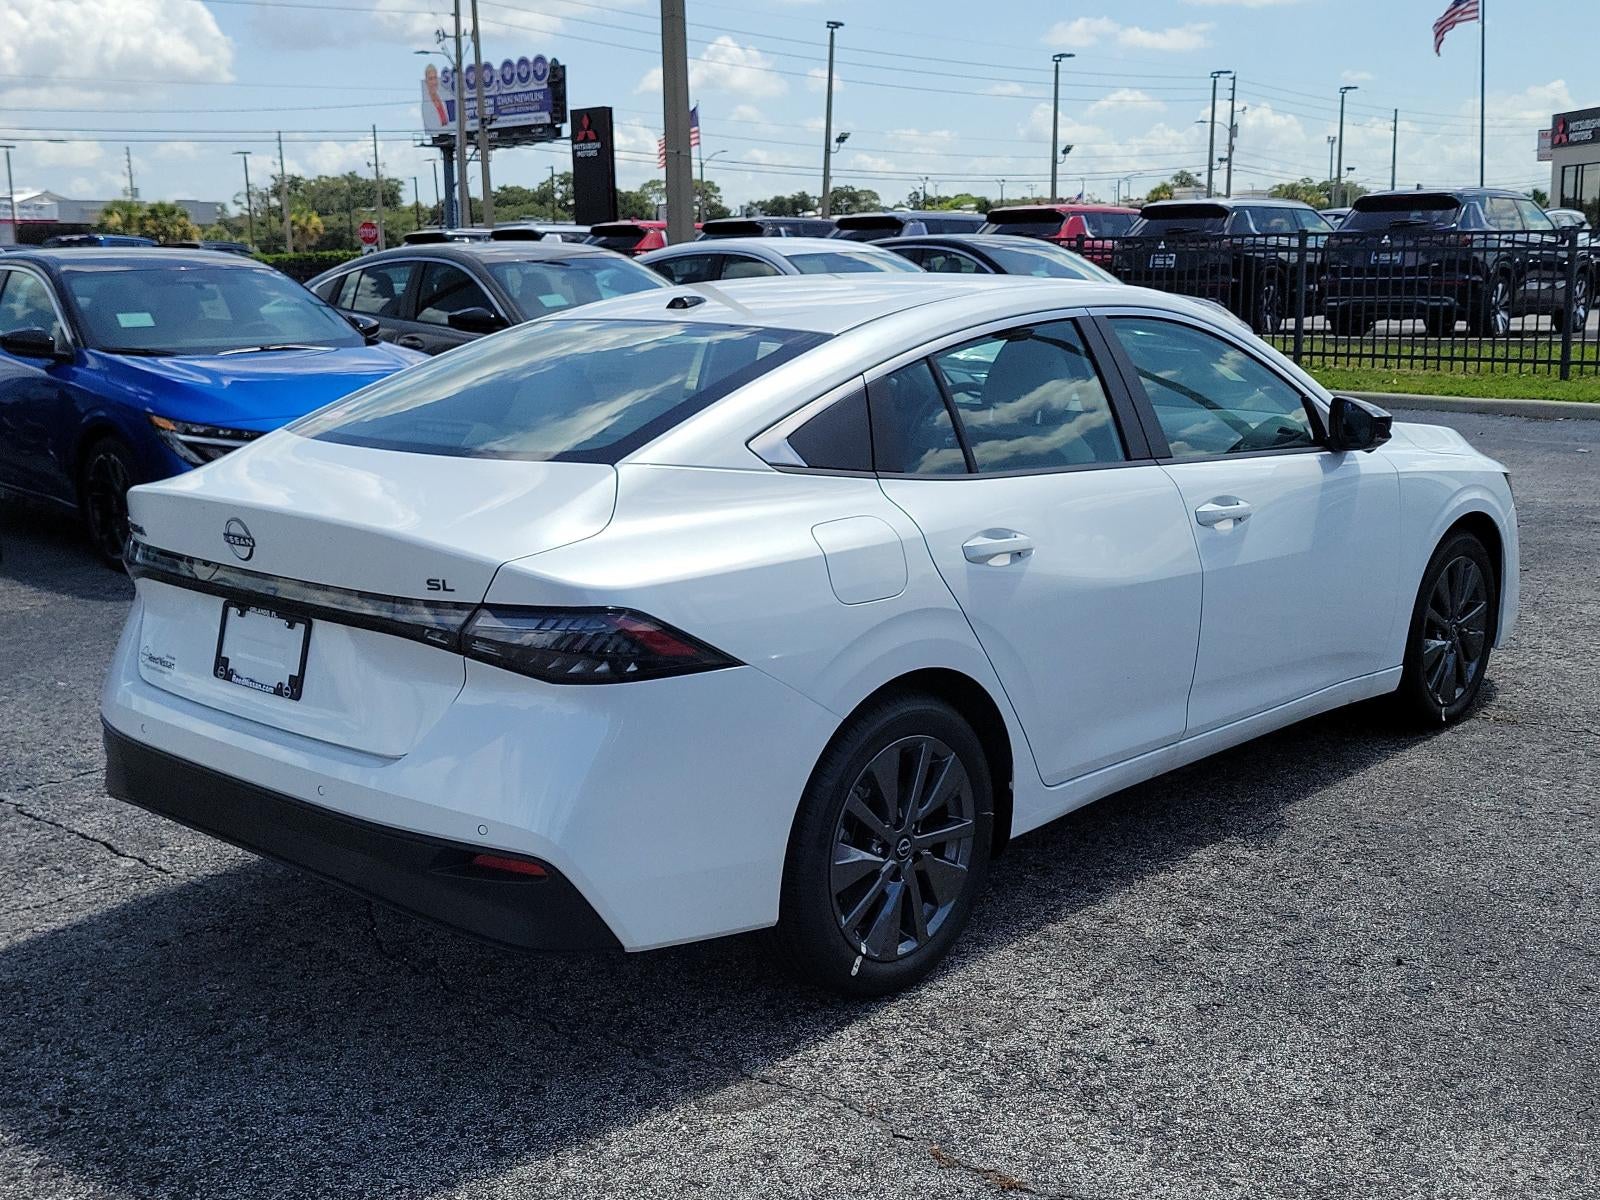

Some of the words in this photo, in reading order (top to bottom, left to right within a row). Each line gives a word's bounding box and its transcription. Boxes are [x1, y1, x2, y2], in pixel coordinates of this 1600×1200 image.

[1569, 119, 1600, 132] MITSUBISH
[1569, 130, 1593, 142] MOTORS
[573, 142, 601, 150] MITSUBISHI
[360, 227, 376, 237] STOP
[426, 578, 455, 592] SL
